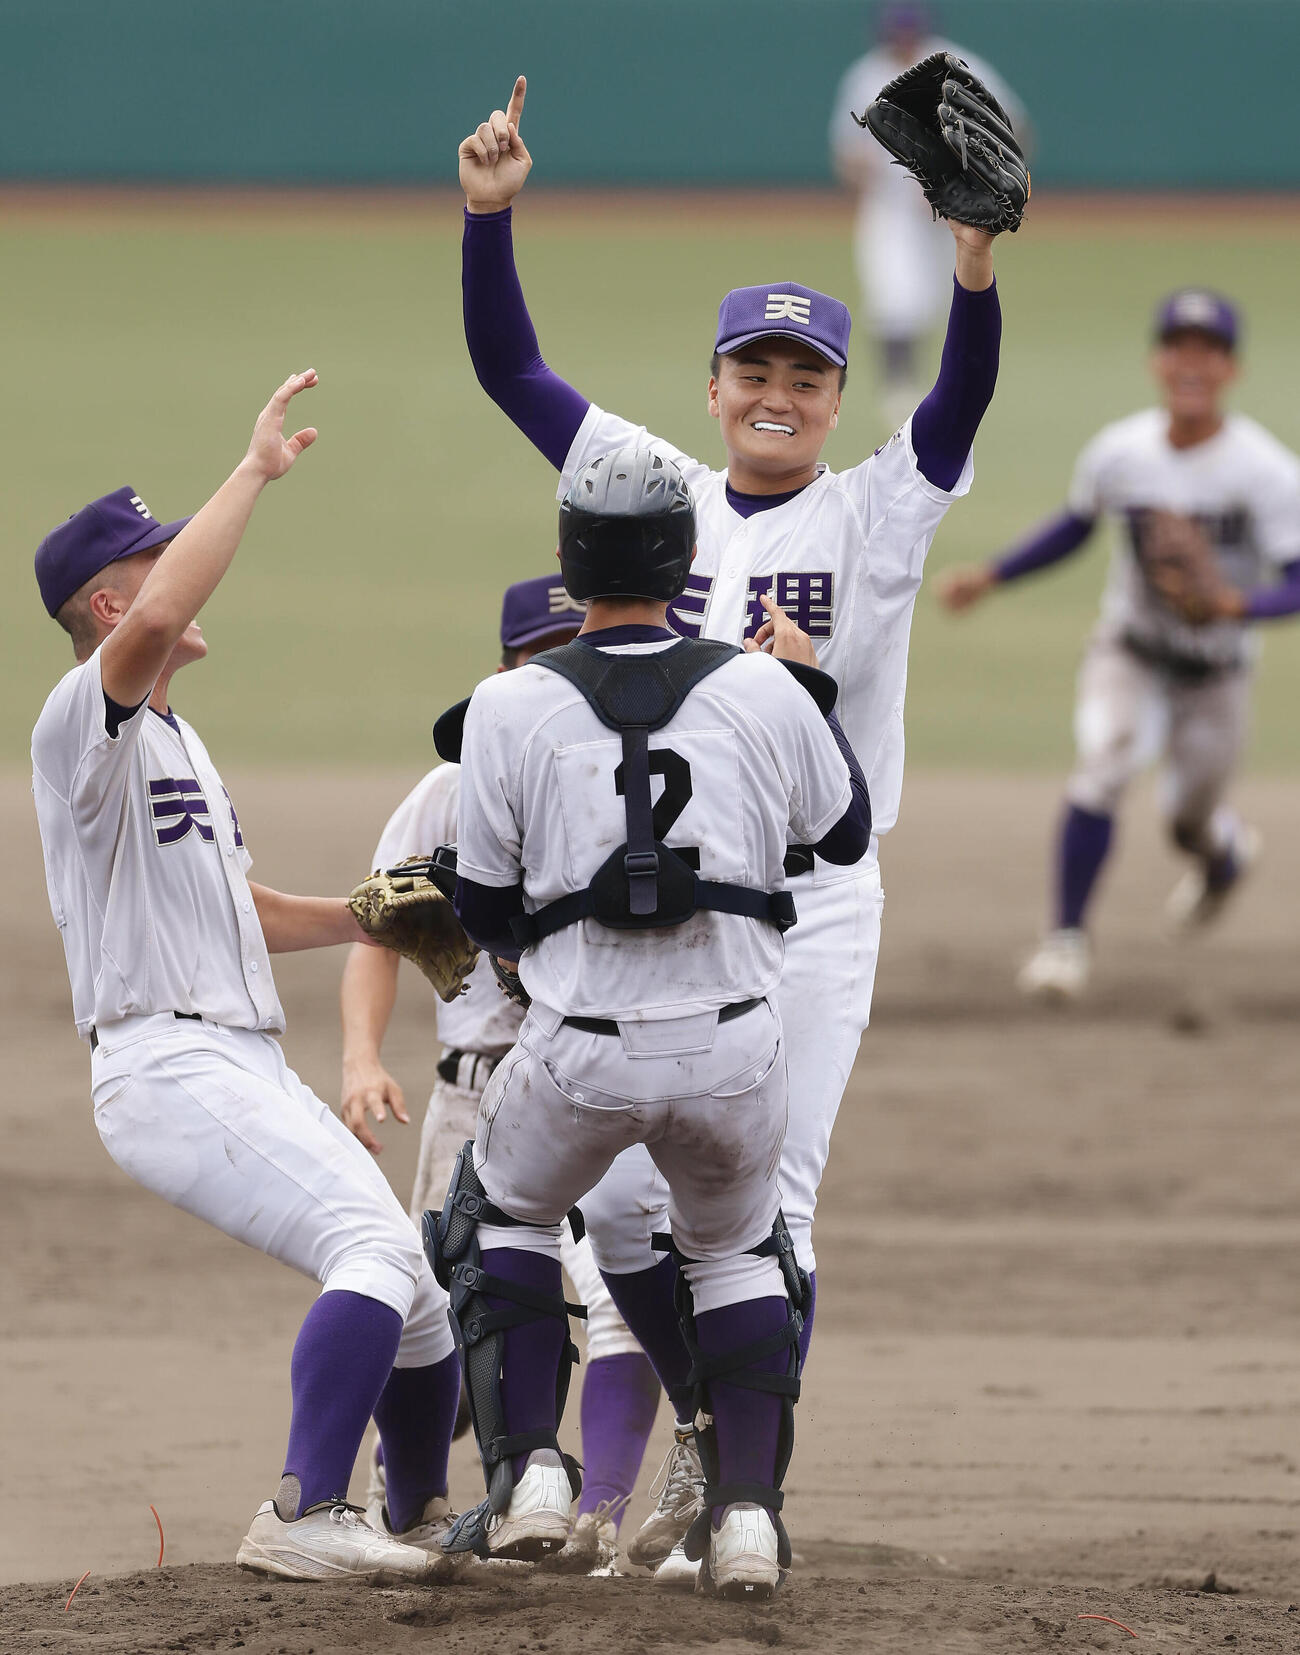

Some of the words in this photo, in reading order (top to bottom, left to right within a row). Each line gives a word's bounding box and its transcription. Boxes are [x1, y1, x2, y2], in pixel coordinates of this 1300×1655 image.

[764, 293, 811, 325] 天
[147, 777, 245, 850] 天
[614, 748, 701, 871] 2
